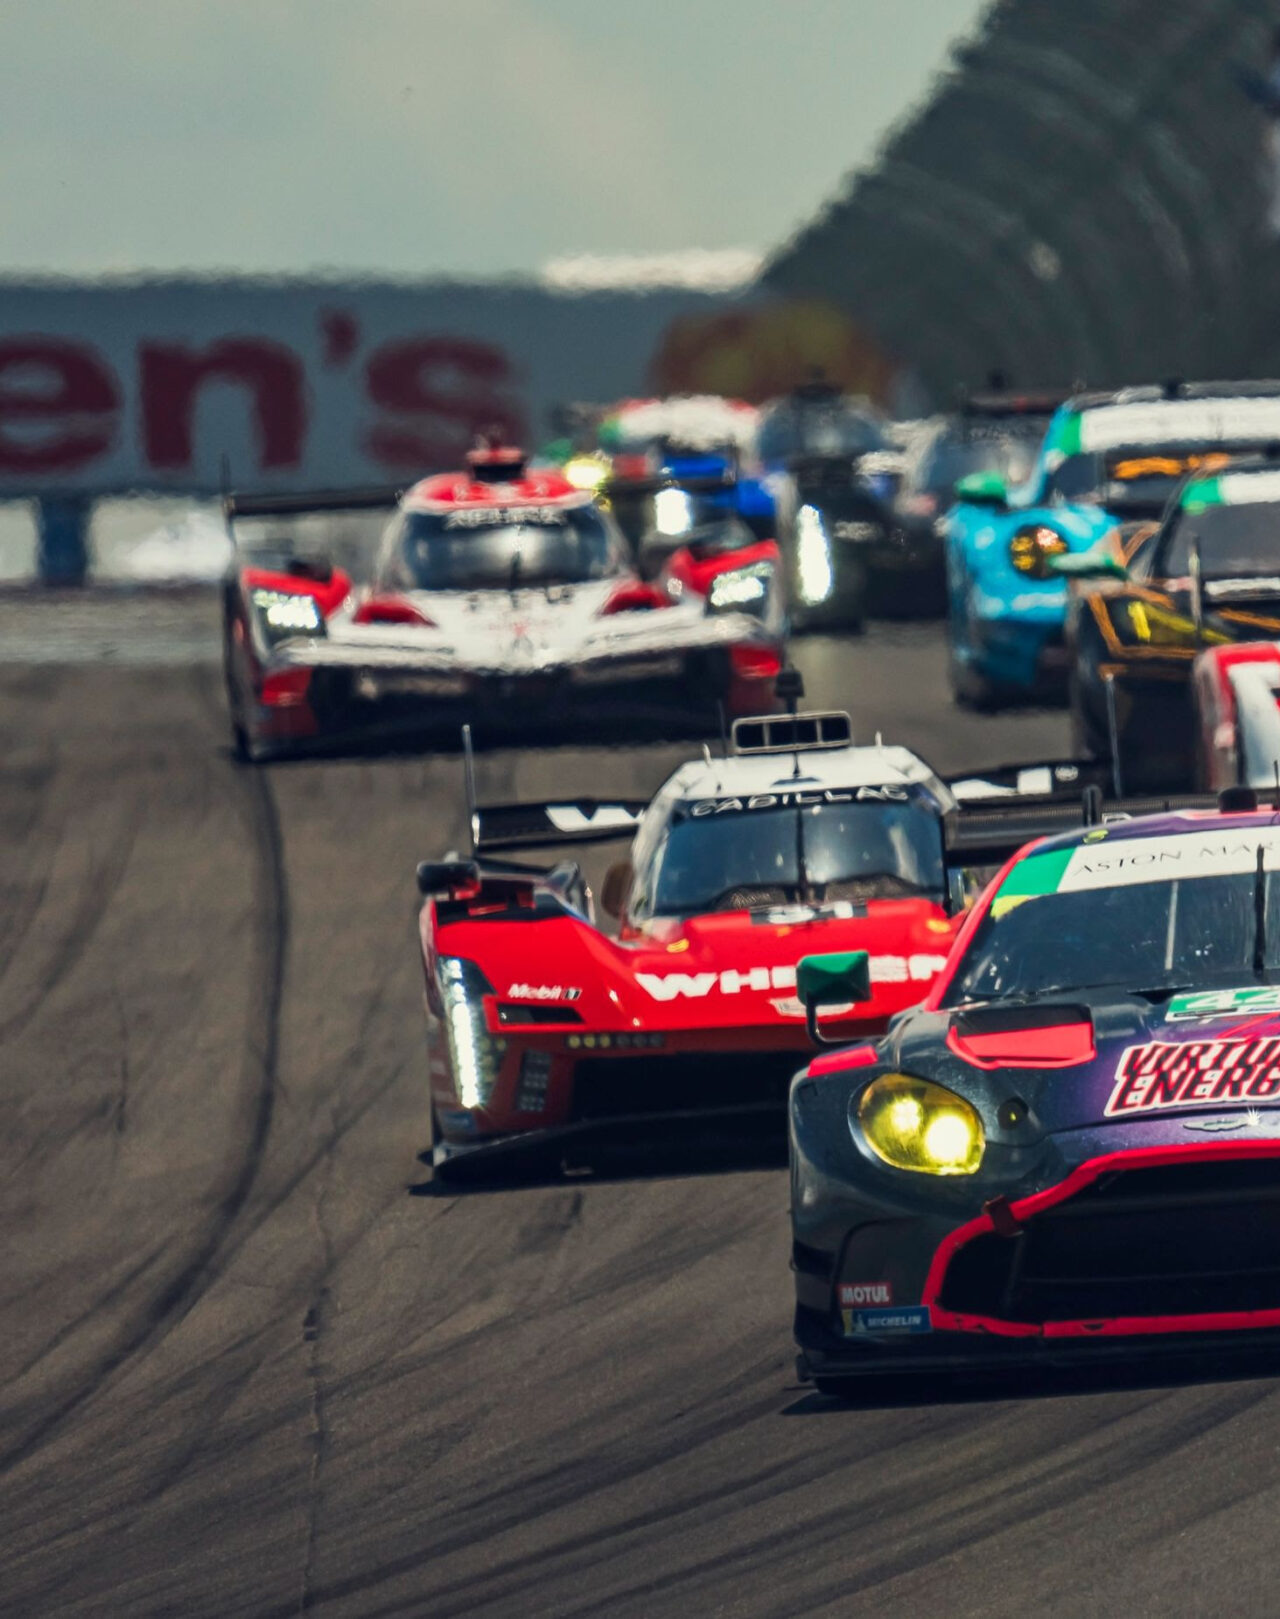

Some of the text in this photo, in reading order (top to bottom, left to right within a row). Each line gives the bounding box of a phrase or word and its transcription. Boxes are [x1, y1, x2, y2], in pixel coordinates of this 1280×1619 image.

[0, 307, 530, 476] en's
[691, 784, 909, 817] CADILLAC
[1073, 850, 1182, 876] ASTON
[508, 983, 562, 1000] Mobil
[634, 954, 950, 1001] WHEEN
[841, 1285, 890, 1303] MOTUL
